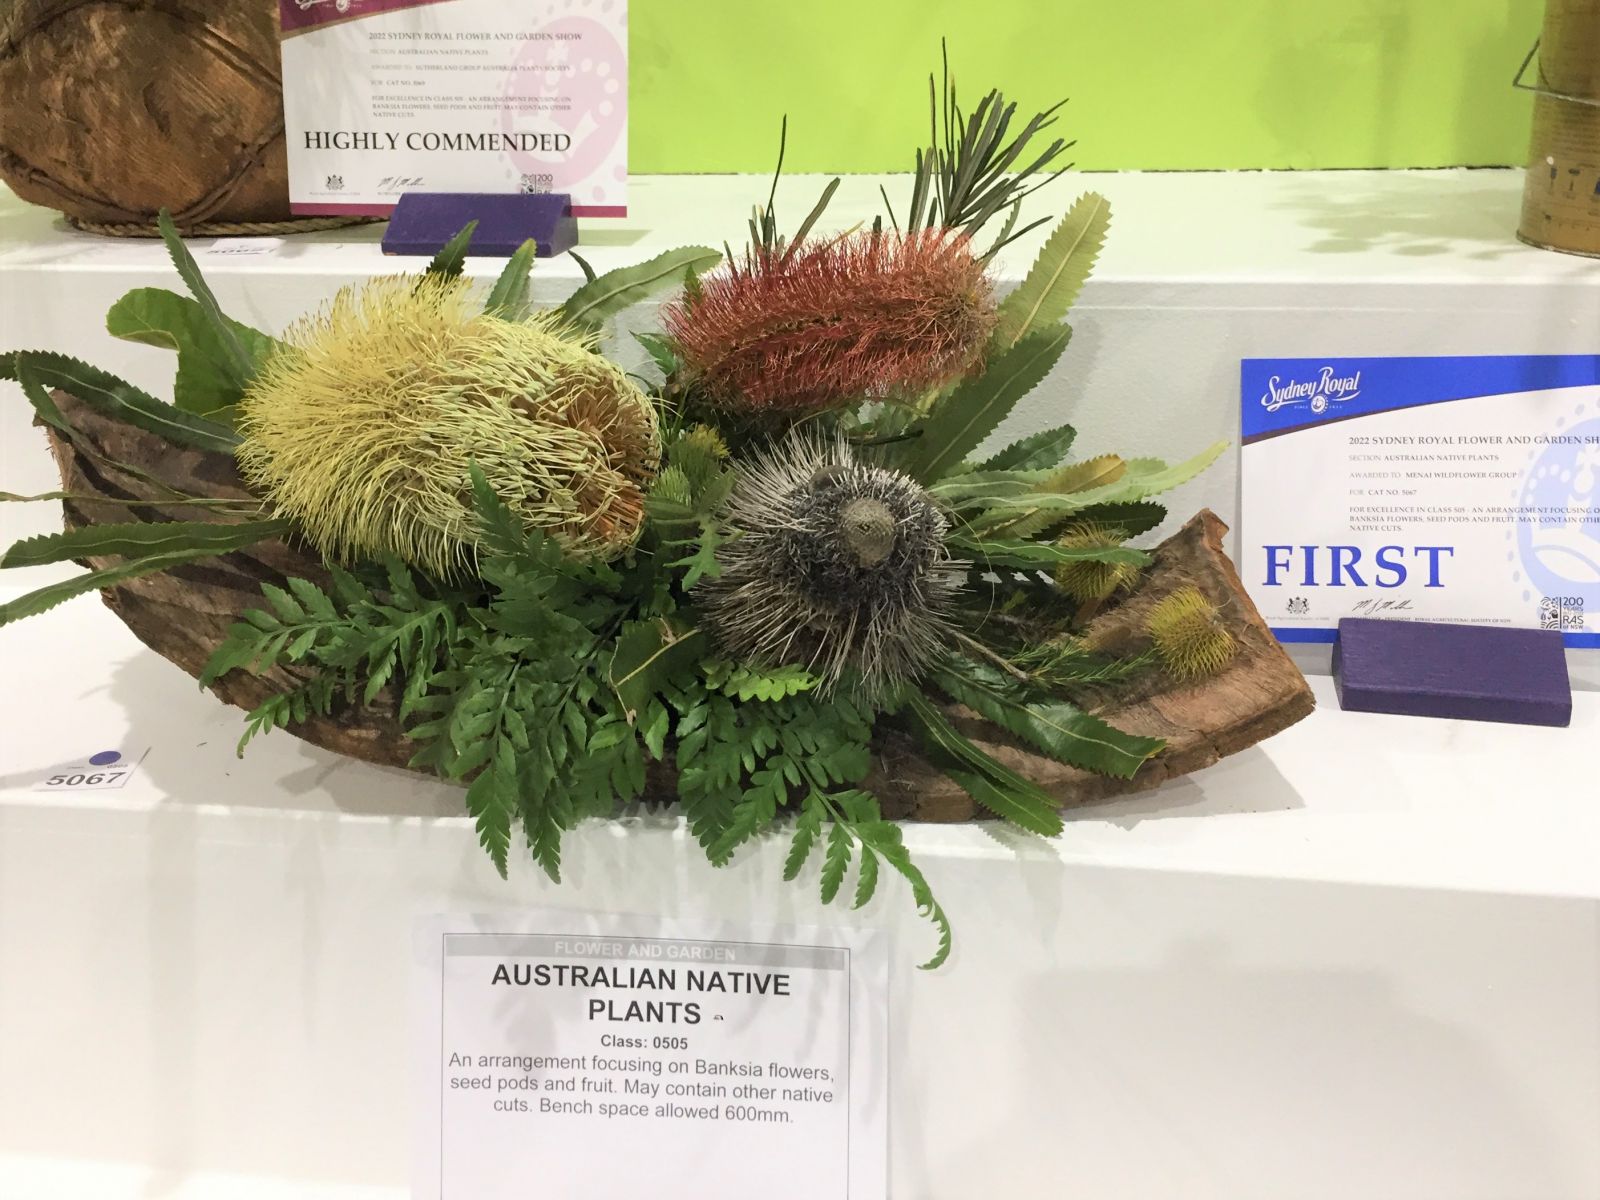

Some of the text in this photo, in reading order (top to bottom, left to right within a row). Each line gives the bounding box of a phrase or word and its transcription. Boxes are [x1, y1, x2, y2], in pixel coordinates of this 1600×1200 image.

[369, 32, 582, 41] 2022 SYDNEY ROYAL FLOWER AND GARDEN SHOW
[303, 131, 571, 152] HIGHLY COMMENDED
[1261, 375, 1317, 412] Sydney
[1317, 366, 1361, 402] Royal
[1349, 436, 1370, 445] 2022
[1372, 436, 1415, 445] SYDNEY
[1418, 436, 1455, 445] ROYAL
[1458, 436, 1502, 444] FLOWER
[1505, 436, 1531, 444] AND
[1534, 435, 1581, 444] GARDEN
[1550, 506, 1592, 514] FOCUSING
[1262, 545, 1454, 588] FIRST
[1563, 596, 1584, 606] 200
[1563, 615, 1584, 624] RAS
[46, 771, 127, 786] 5067
[554, 941, 736, 961] FLOWER AND GARDEN
[491, 964, 791, 996] AUSTRALIAN NATIVE
[588, 999, 701, 1025] PLANTS
[600, 1034, 688, 1050] Class: 0505
[449, 1052, 834, 1083] An arrangement focusing on Banksia flowers,
[450, 1075, 833, 1103] seed pods and fruit. May contain other native
[493, 1098, 794, 1123] cuts. Bench space allowed 600mm.
